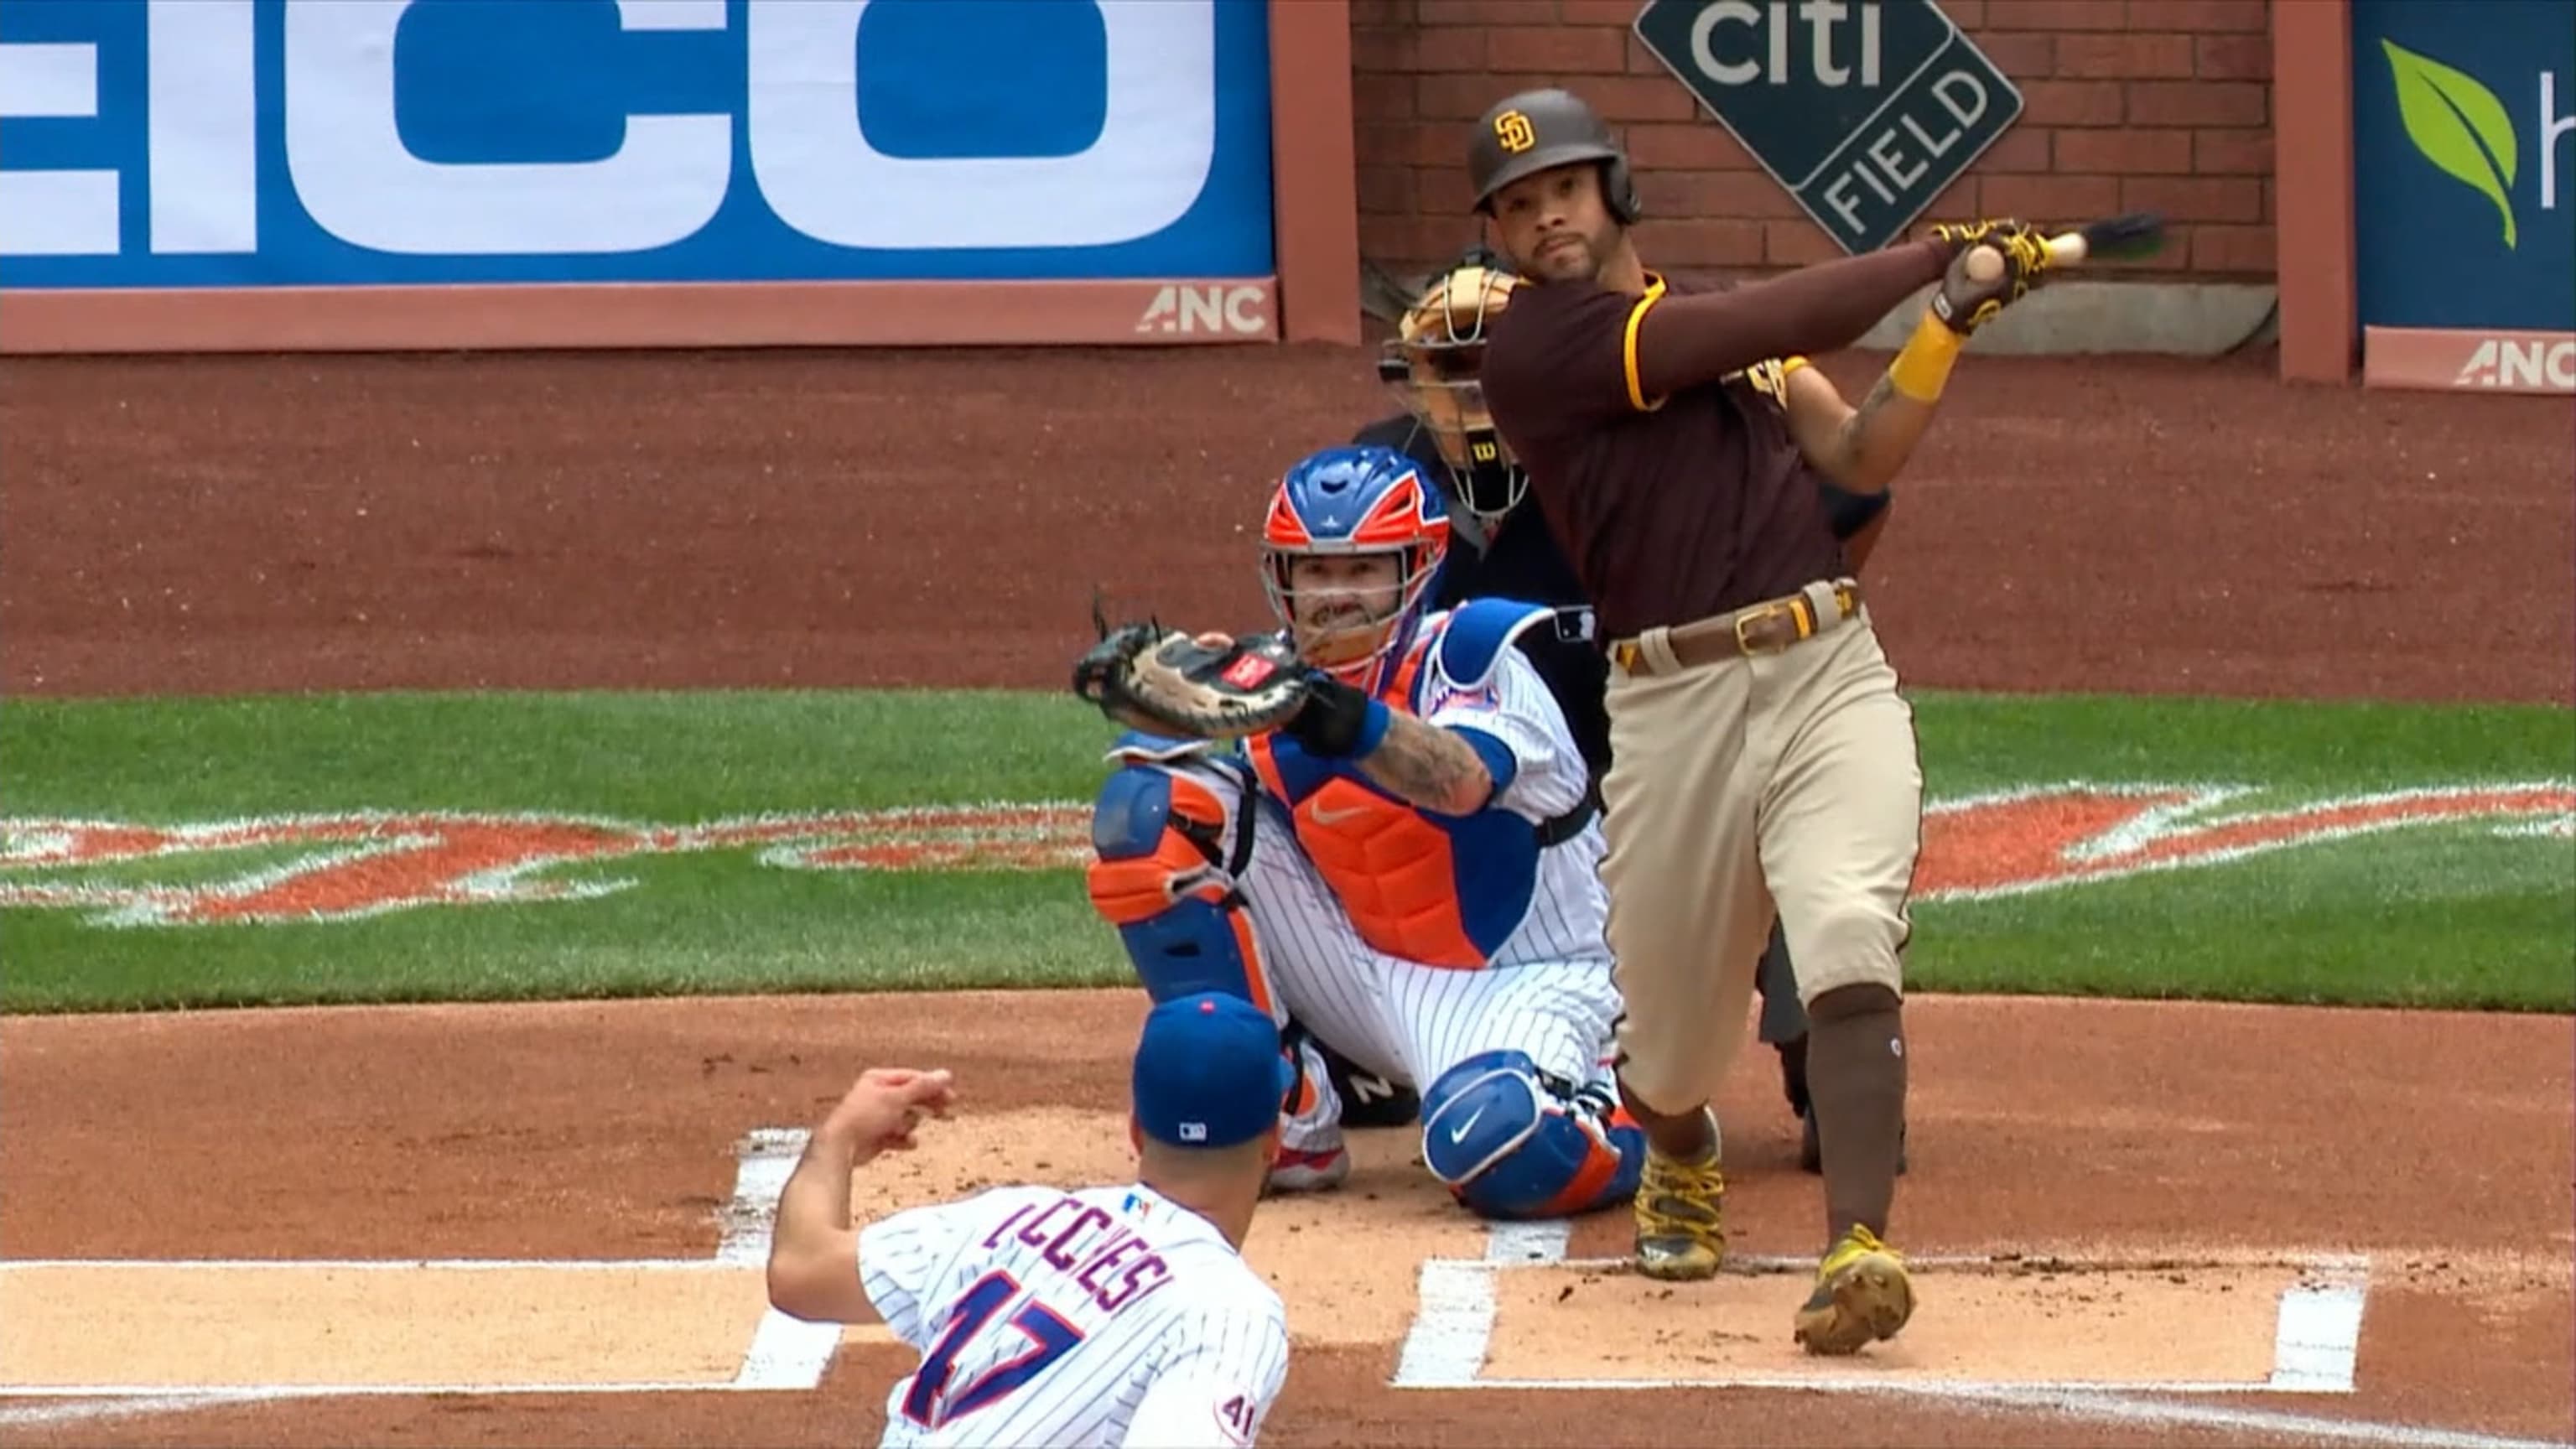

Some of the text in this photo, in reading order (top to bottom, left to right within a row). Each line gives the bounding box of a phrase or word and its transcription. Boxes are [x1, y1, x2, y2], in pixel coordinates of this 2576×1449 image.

[1823, 70, 1988, 236] FIELD
[1135, 286, 1266, 333] ANC
[2454, 340, 2576, 387] ANC
[901, 1269, 1087, 1430] 17
[1222, 1394, 1255, 1437] 41
